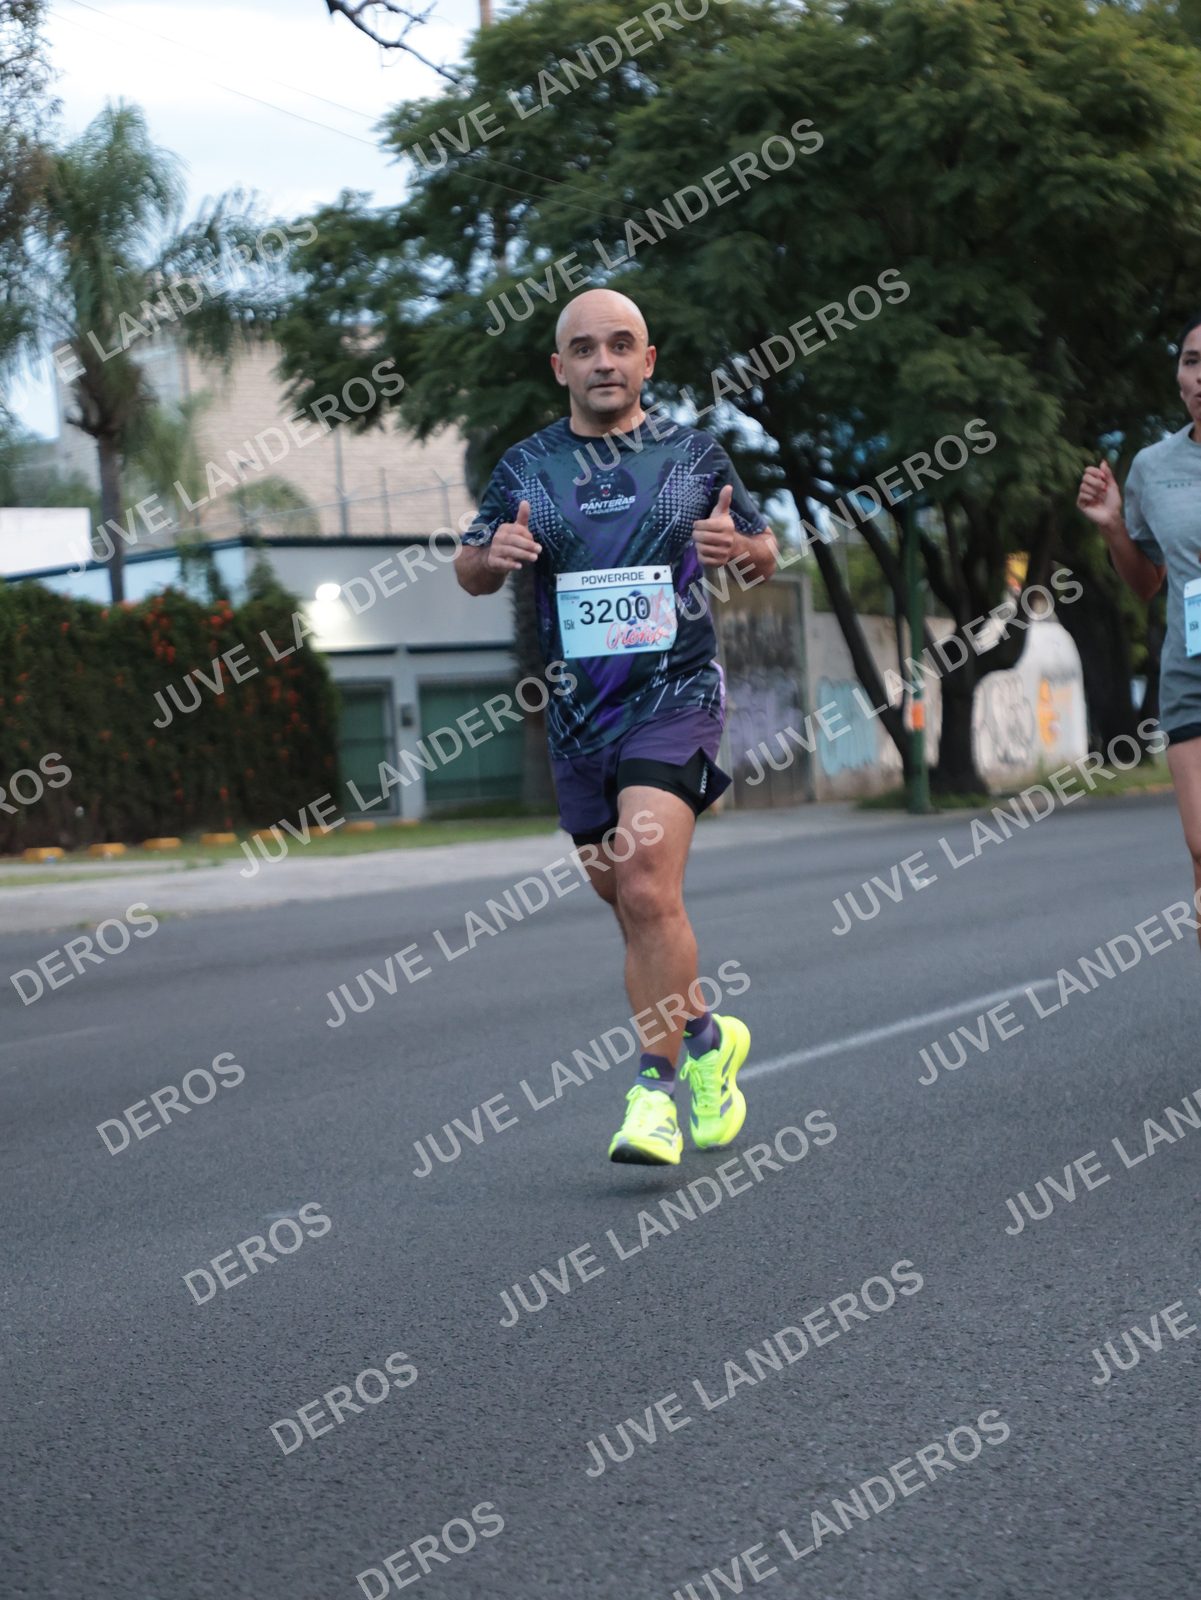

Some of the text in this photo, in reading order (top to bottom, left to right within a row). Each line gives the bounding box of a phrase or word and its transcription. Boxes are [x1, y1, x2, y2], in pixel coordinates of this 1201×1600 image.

[580, 496, 636, 511] PANTERAS
[581, 571, 645, 585] POWERADE
[578, 596, 651, 625] 3200
